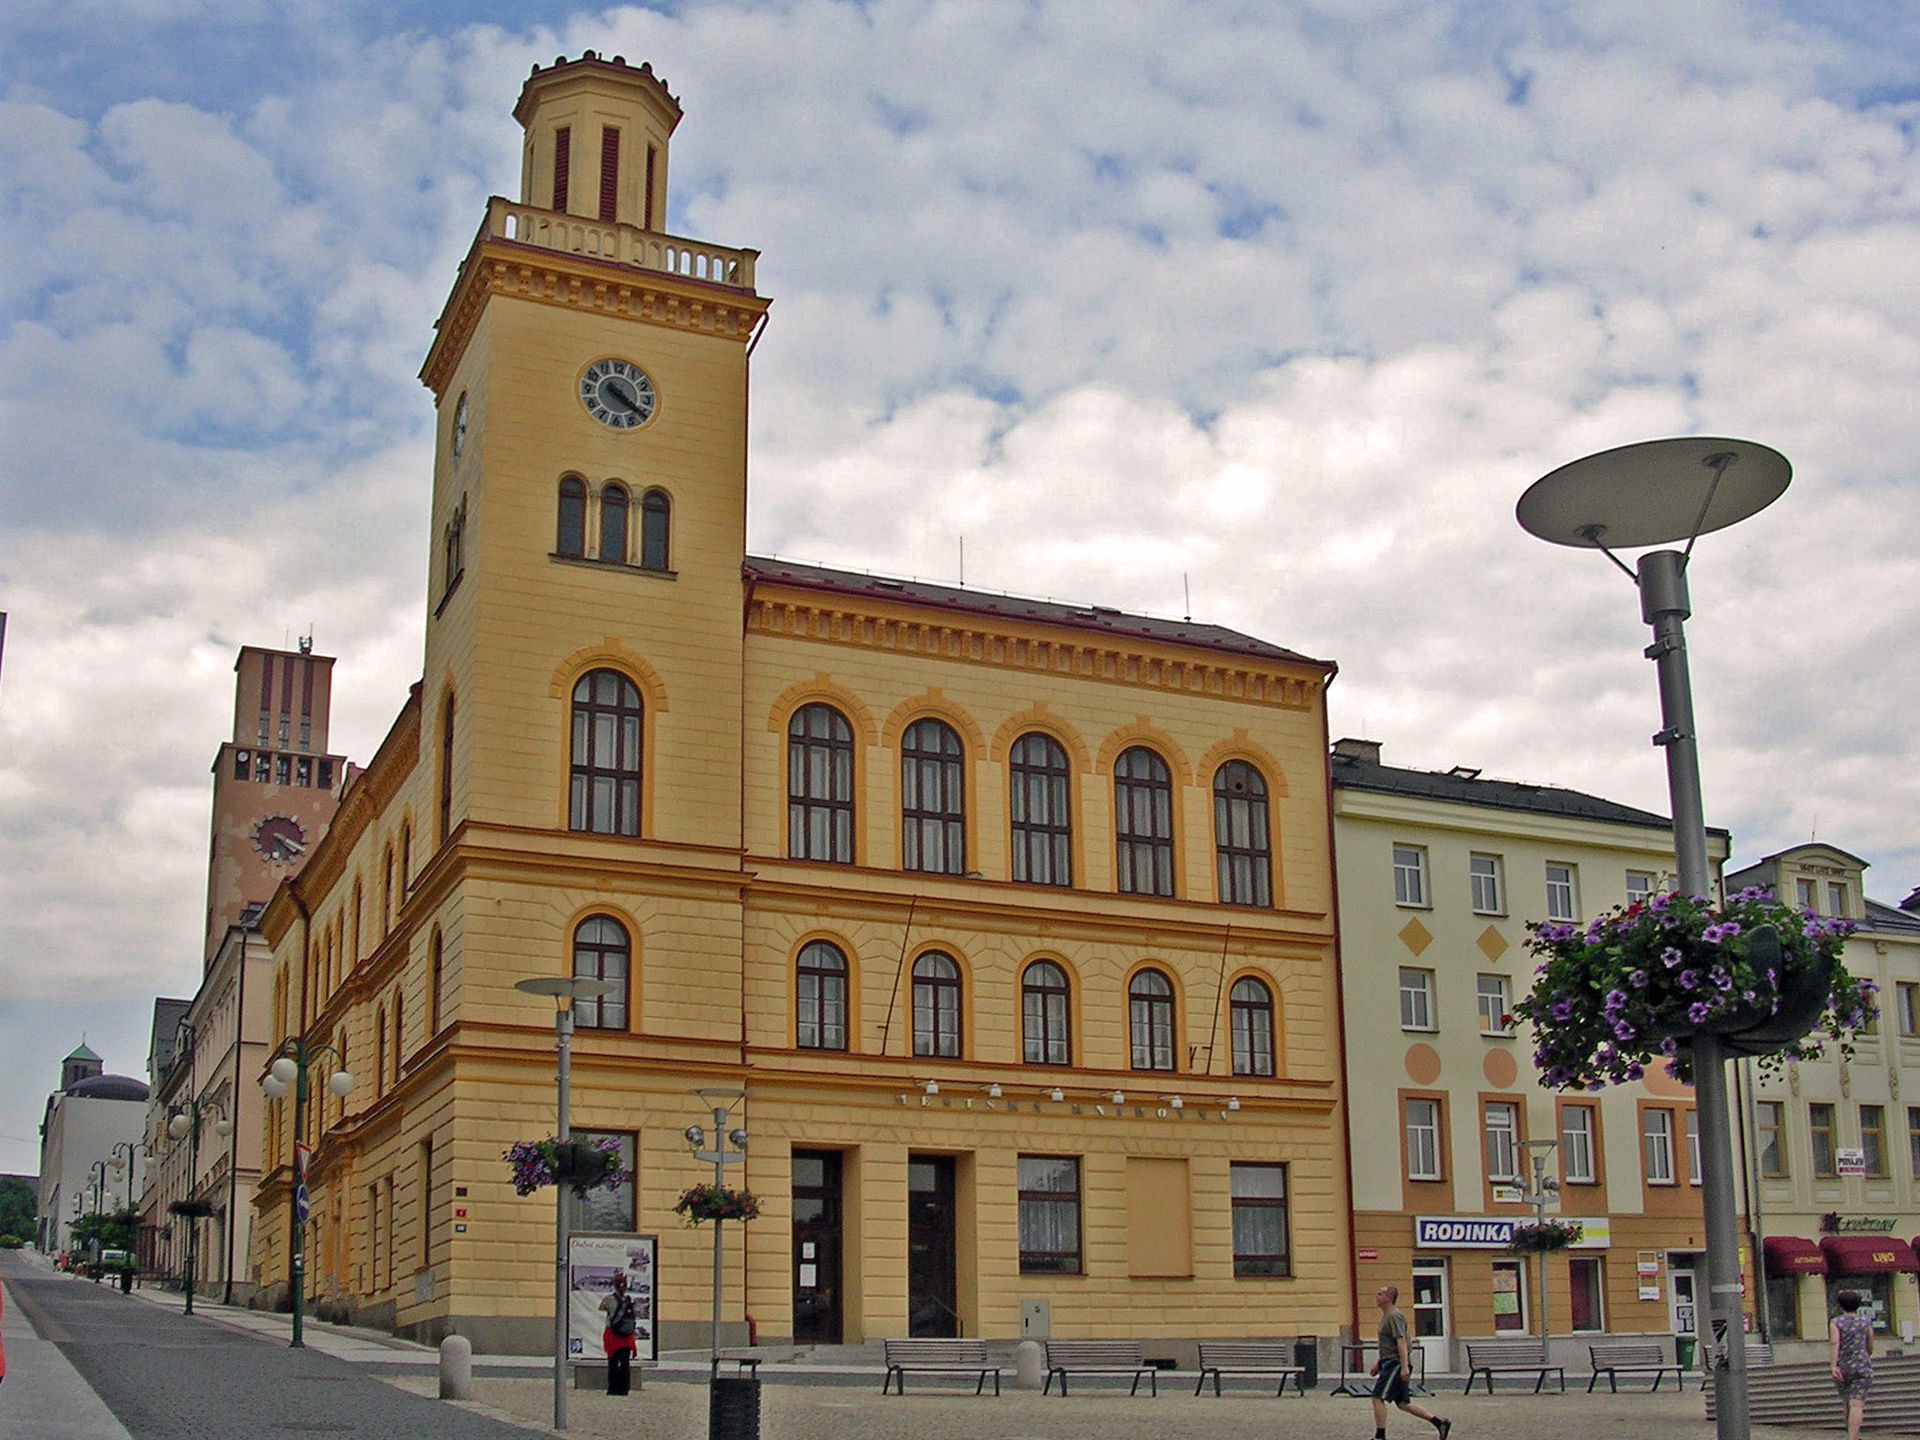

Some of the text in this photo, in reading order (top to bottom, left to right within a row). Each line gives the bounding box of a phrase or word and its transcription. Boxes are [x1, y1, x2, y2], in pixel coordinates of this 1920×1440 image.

[585, 384, 592, 394] 9
[640, 382, 648, 391] 2
[643, 395, 651, 406] 3
[1424, 1223, 1511, 1241] RODINKA
